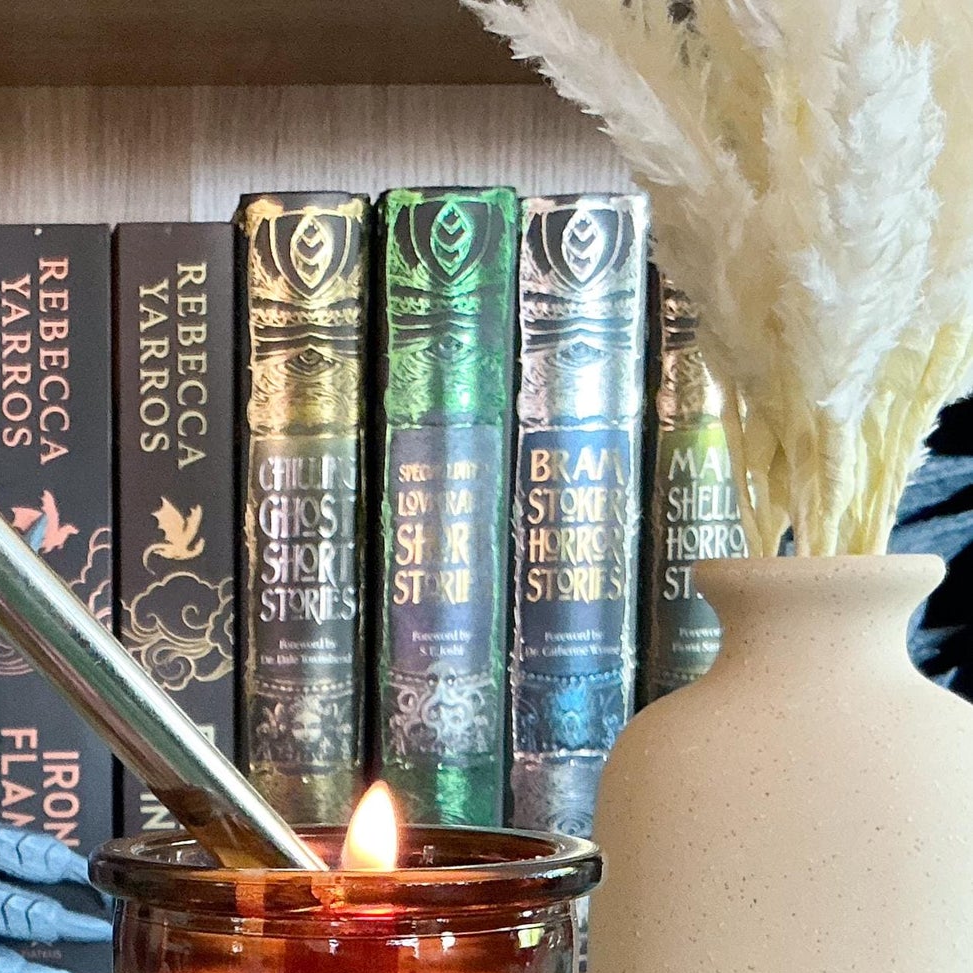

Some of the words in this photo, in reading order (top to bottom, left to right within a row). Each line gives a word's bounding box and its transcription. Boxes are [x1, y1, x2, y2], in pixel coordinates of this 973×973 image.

[0, 273, 32, 447] YARROS
[38, 257, 70, 465] REBECCA
[139, 279, 170, 452] YARROS
[177, 262, 207, 470] REBECCA
[530, 446, 625, 485] BRAM
[259, 494, 356, 540] GHOST
[527, 487, 624, 524] STOKER
[261, 540, 355, 586] SHORT
[528, 524, 622, 566] HORROR
[260, 586, 356, 626] STORIES
[526, 566, 623, 604] STORIES
[42, 751, 80, 847] IRON
